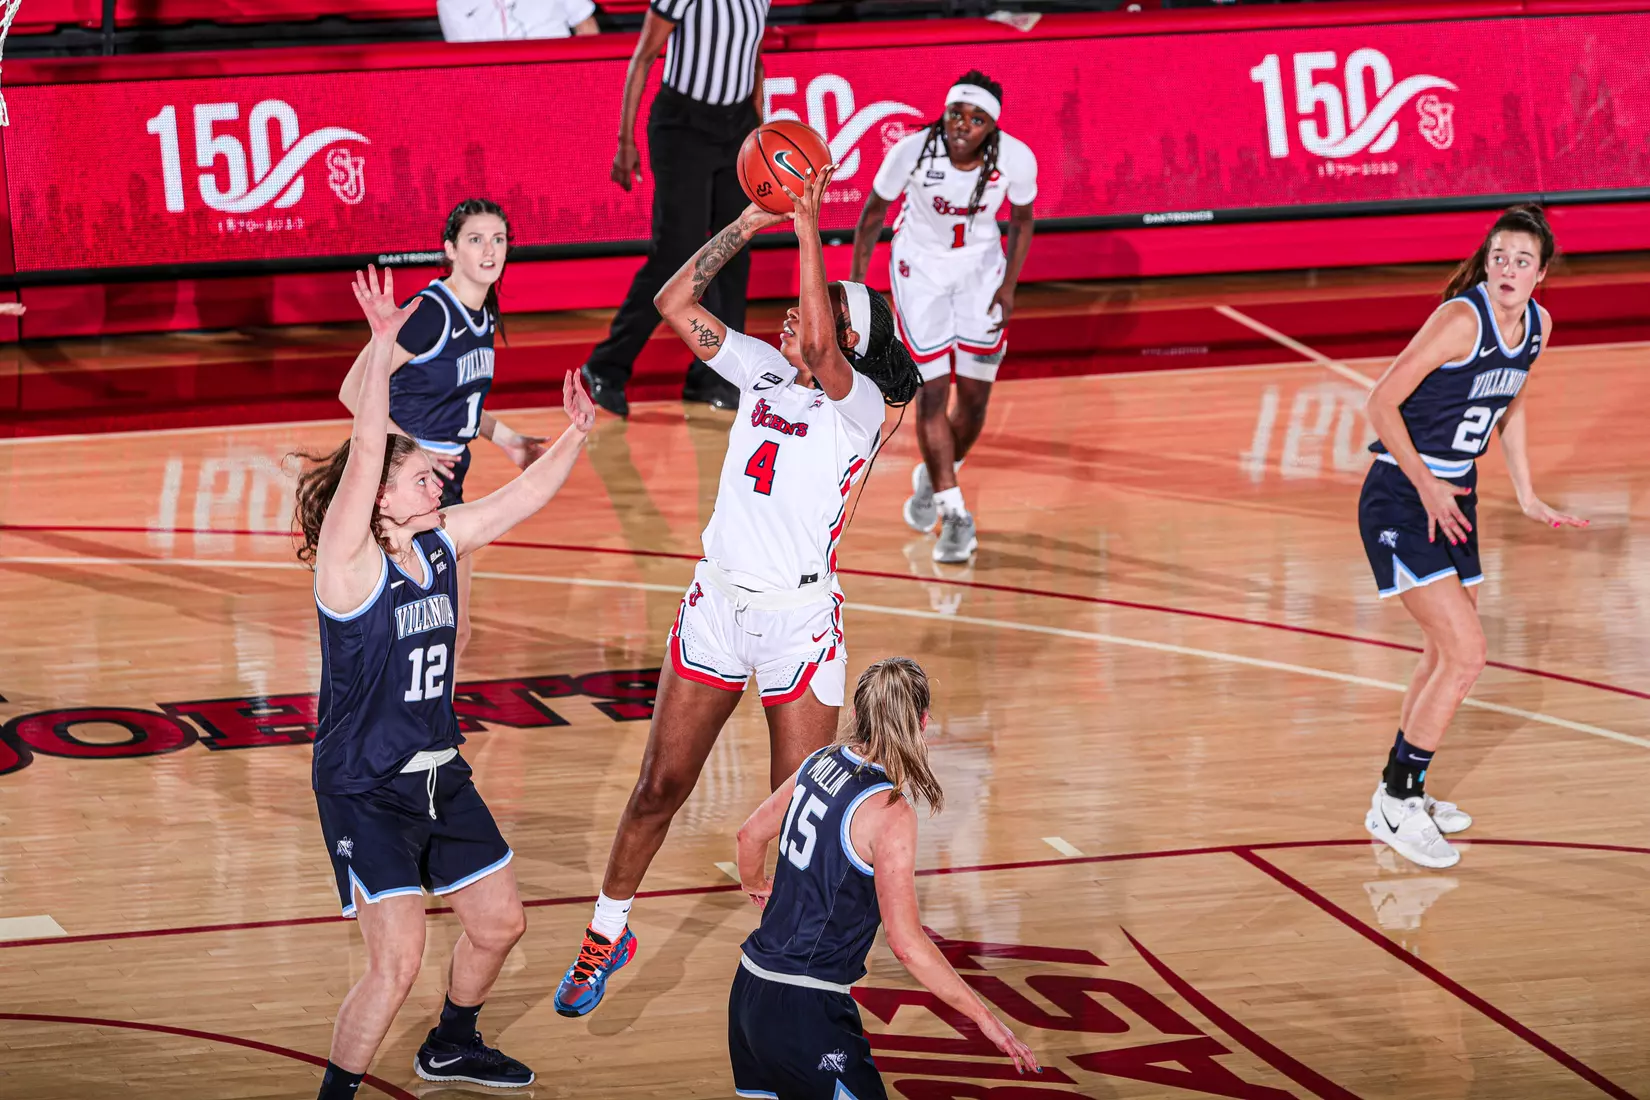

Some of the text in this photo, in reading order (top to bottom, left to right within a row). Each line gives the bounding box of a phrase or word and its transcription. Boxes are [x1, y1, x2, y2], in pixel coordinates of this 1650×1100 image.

[1250, 48, 1399, 158] 150
[147, 99, 305, 213] 150
[951, 223, 966, 249] 1
[744, 440, 780, 497] 4
[404, 643, 448, 702] 12
[807, 755, 853, 798] MULLIN
[779, 783, 829, 871] 15
